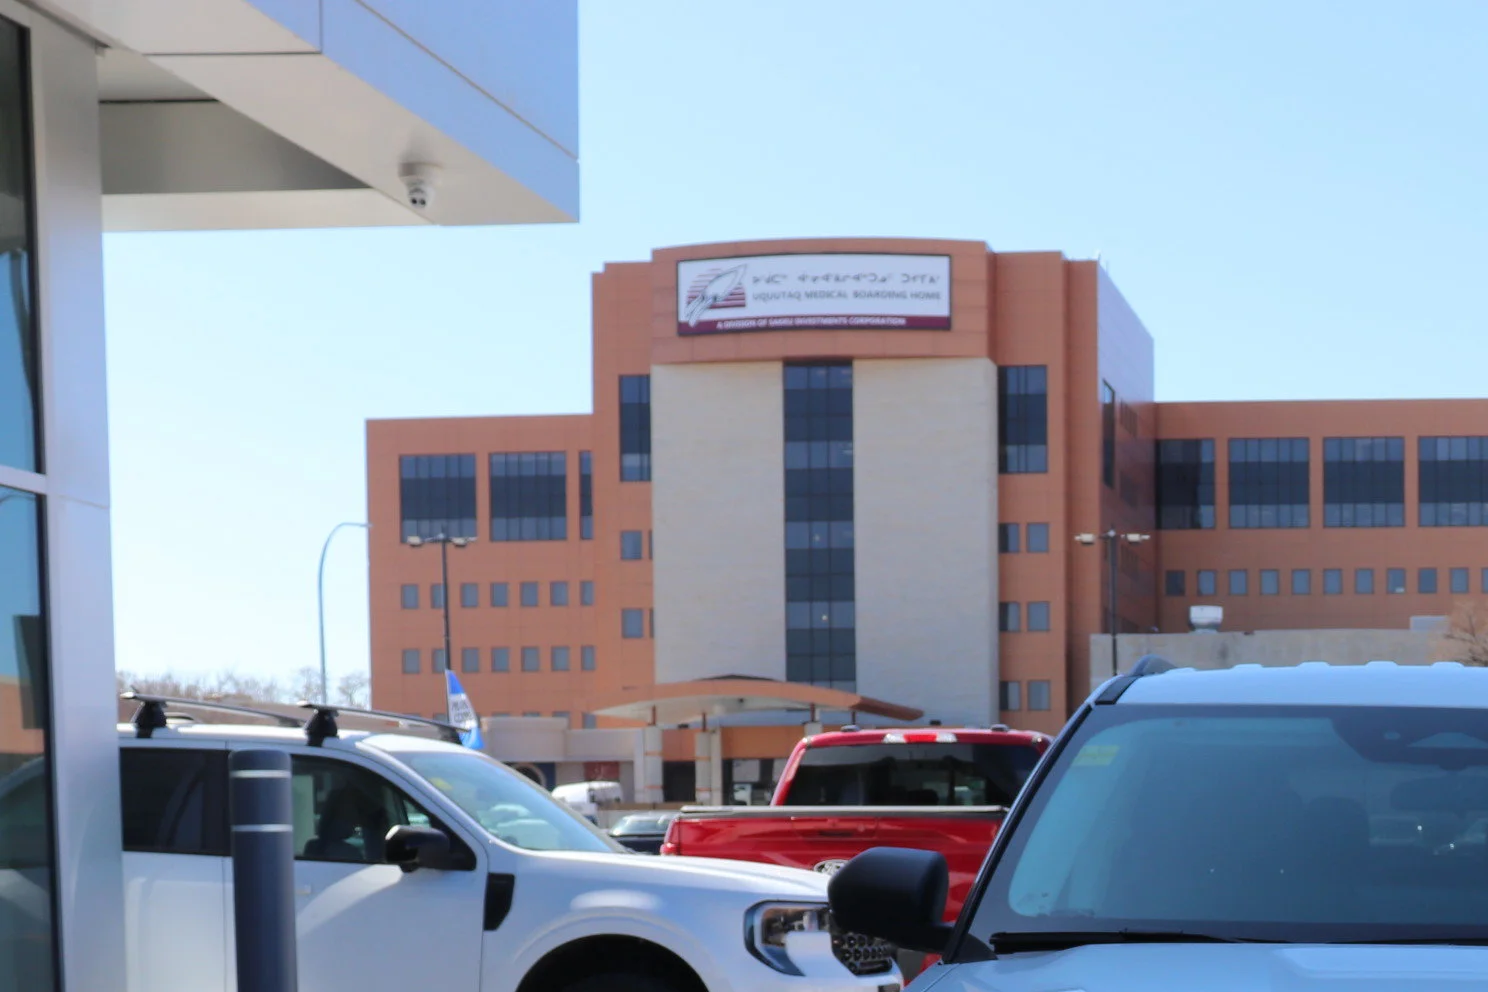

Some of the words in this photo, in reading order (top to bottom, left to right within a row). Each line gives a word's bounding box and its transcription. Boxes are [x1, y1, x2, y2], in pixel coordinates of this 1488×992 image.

[804, 289, 848, 300] MEDICAL
[853, 289, 907, 300] BOARDING
[910, 290, 941, 300] HOME
